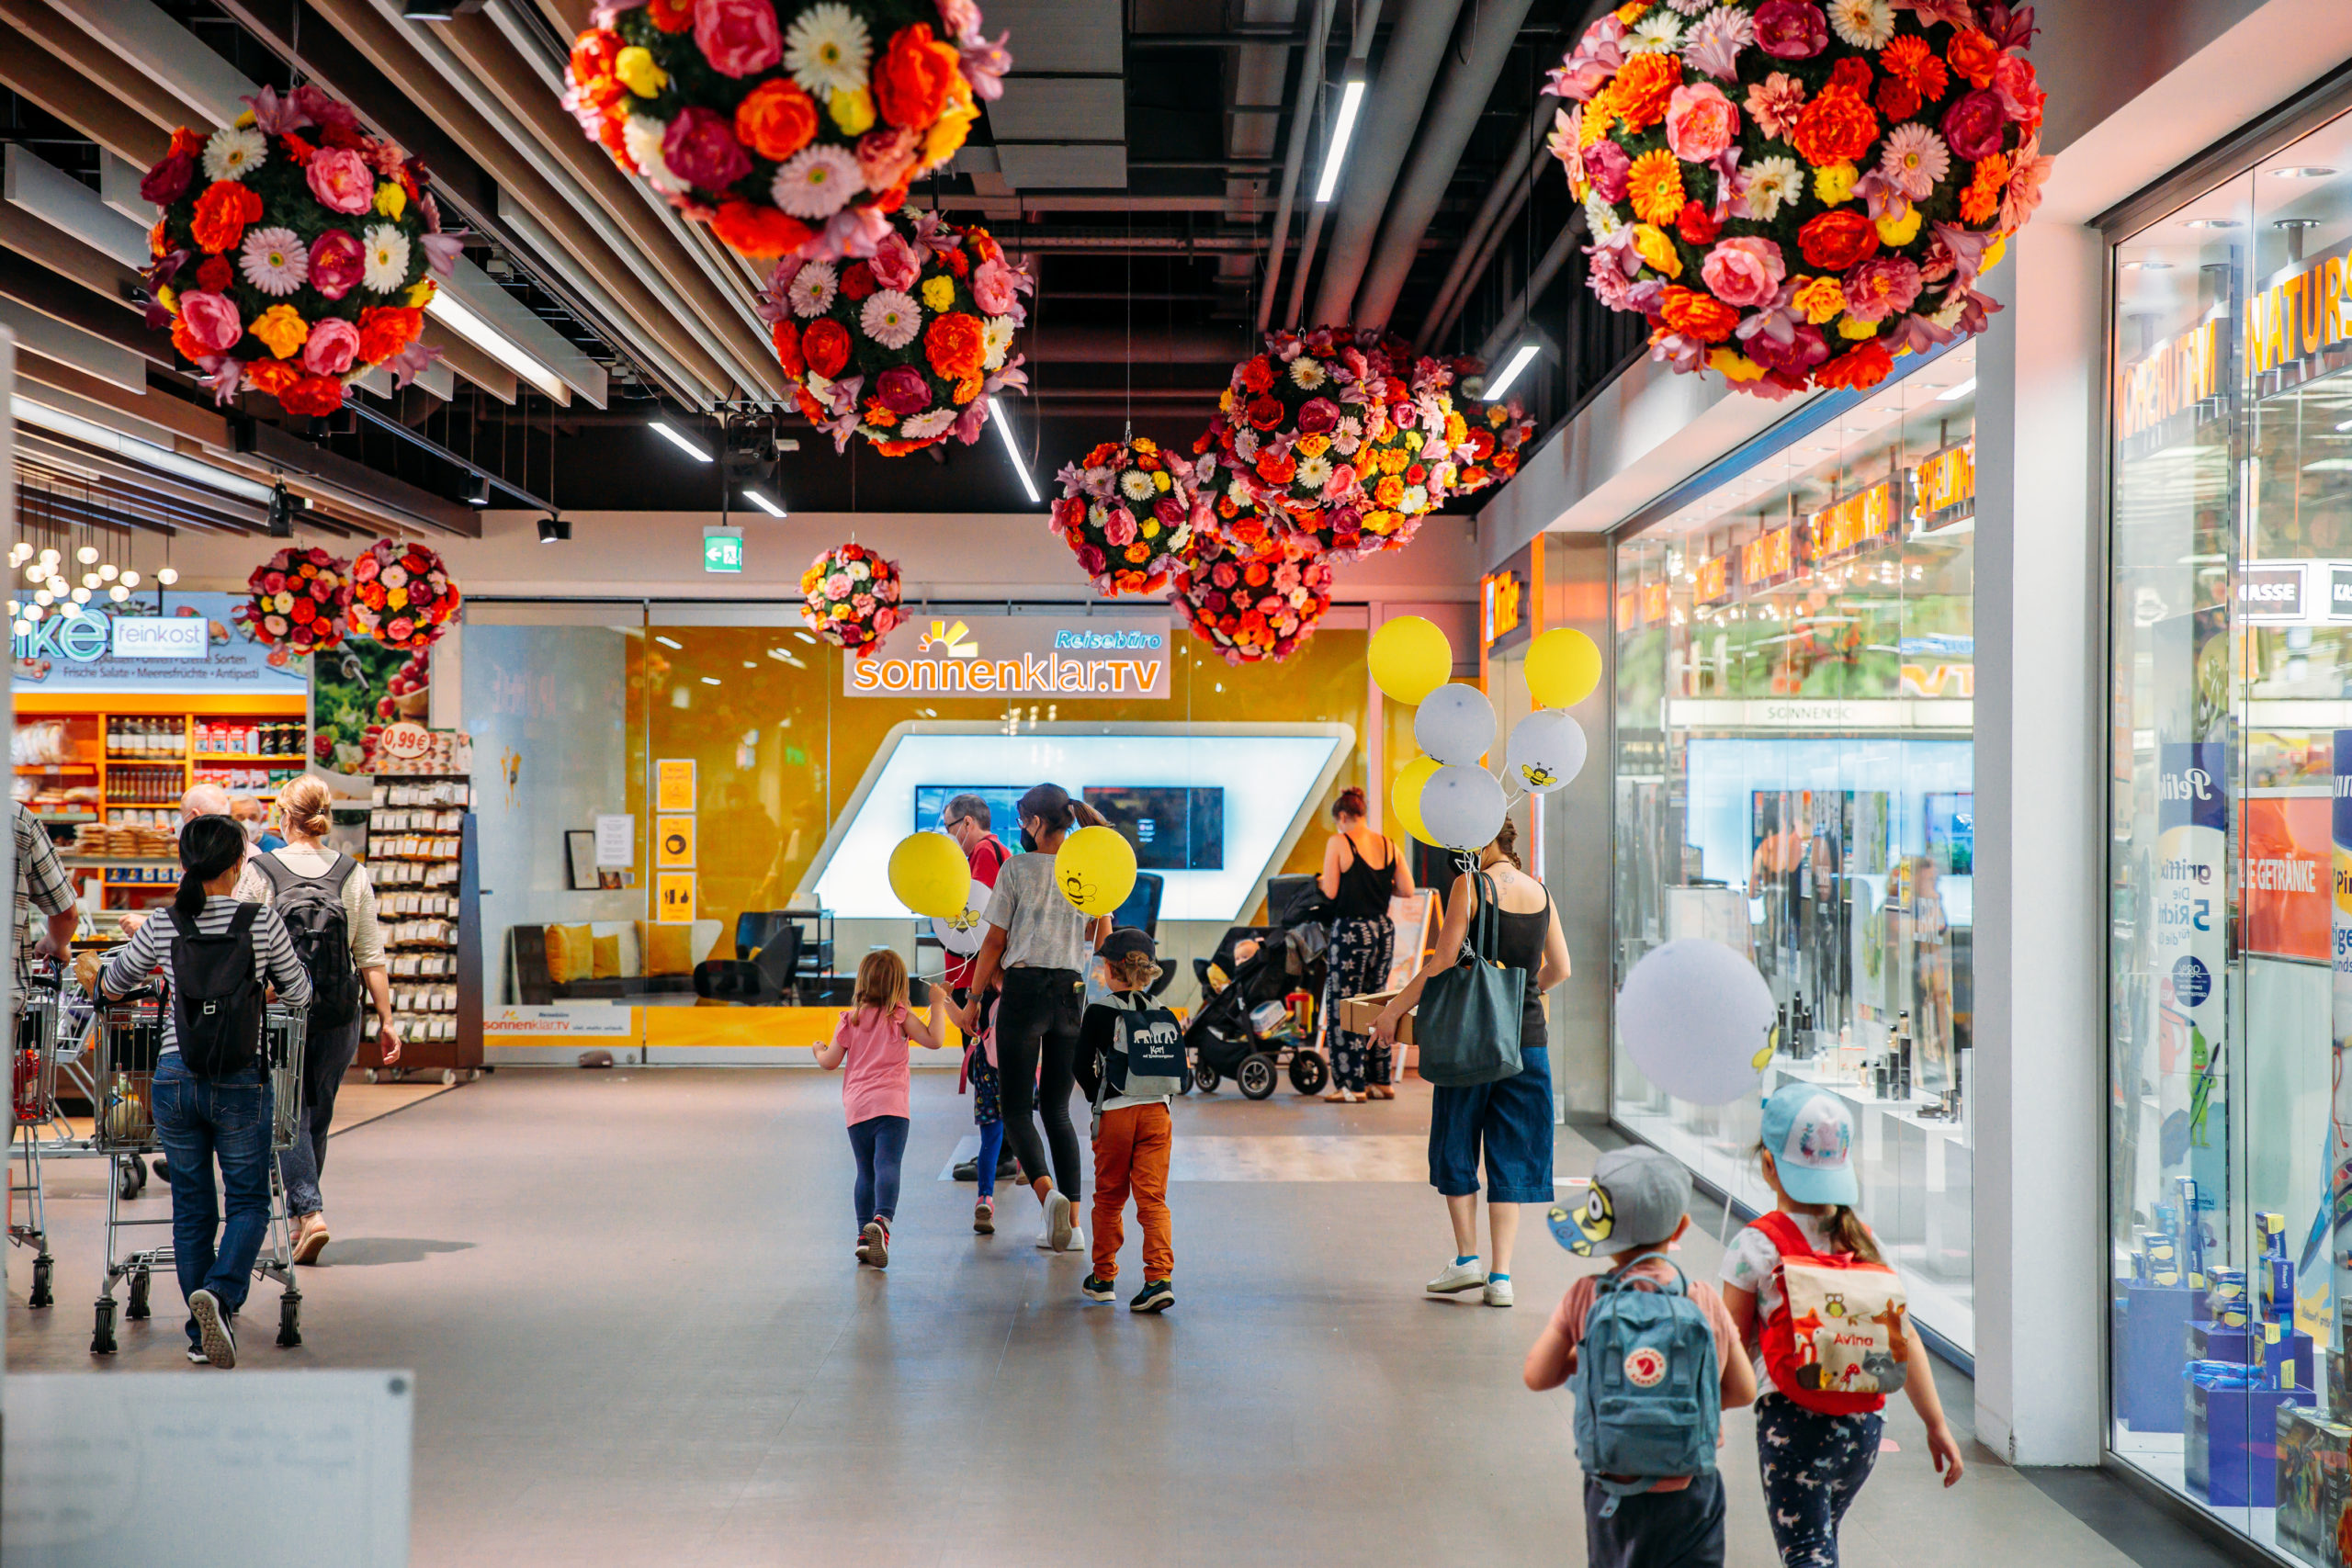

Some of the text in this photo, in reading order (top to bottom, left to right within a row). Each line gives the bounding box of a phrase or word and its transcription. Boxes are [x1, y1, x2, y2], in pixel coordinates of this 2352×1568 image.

[119, 624, 200, 643] feinkost
[1056, 630, 1161, 649] Reisebüro
[215, 654, 246, 664] Sorten
[63, 667, 259, 679] Frische Salate Meeresfrüchte Antipasti
[853, 653, 1161, 692] sonnenklar.TV
[385, 728, 427, 750] 0,99€
[2257, 852, 2316, 893] GETRÄNKE
[483, 1019, 571, 1031] sonnenklar.TV
[1834, 1333, 1874, 1347] Avina
